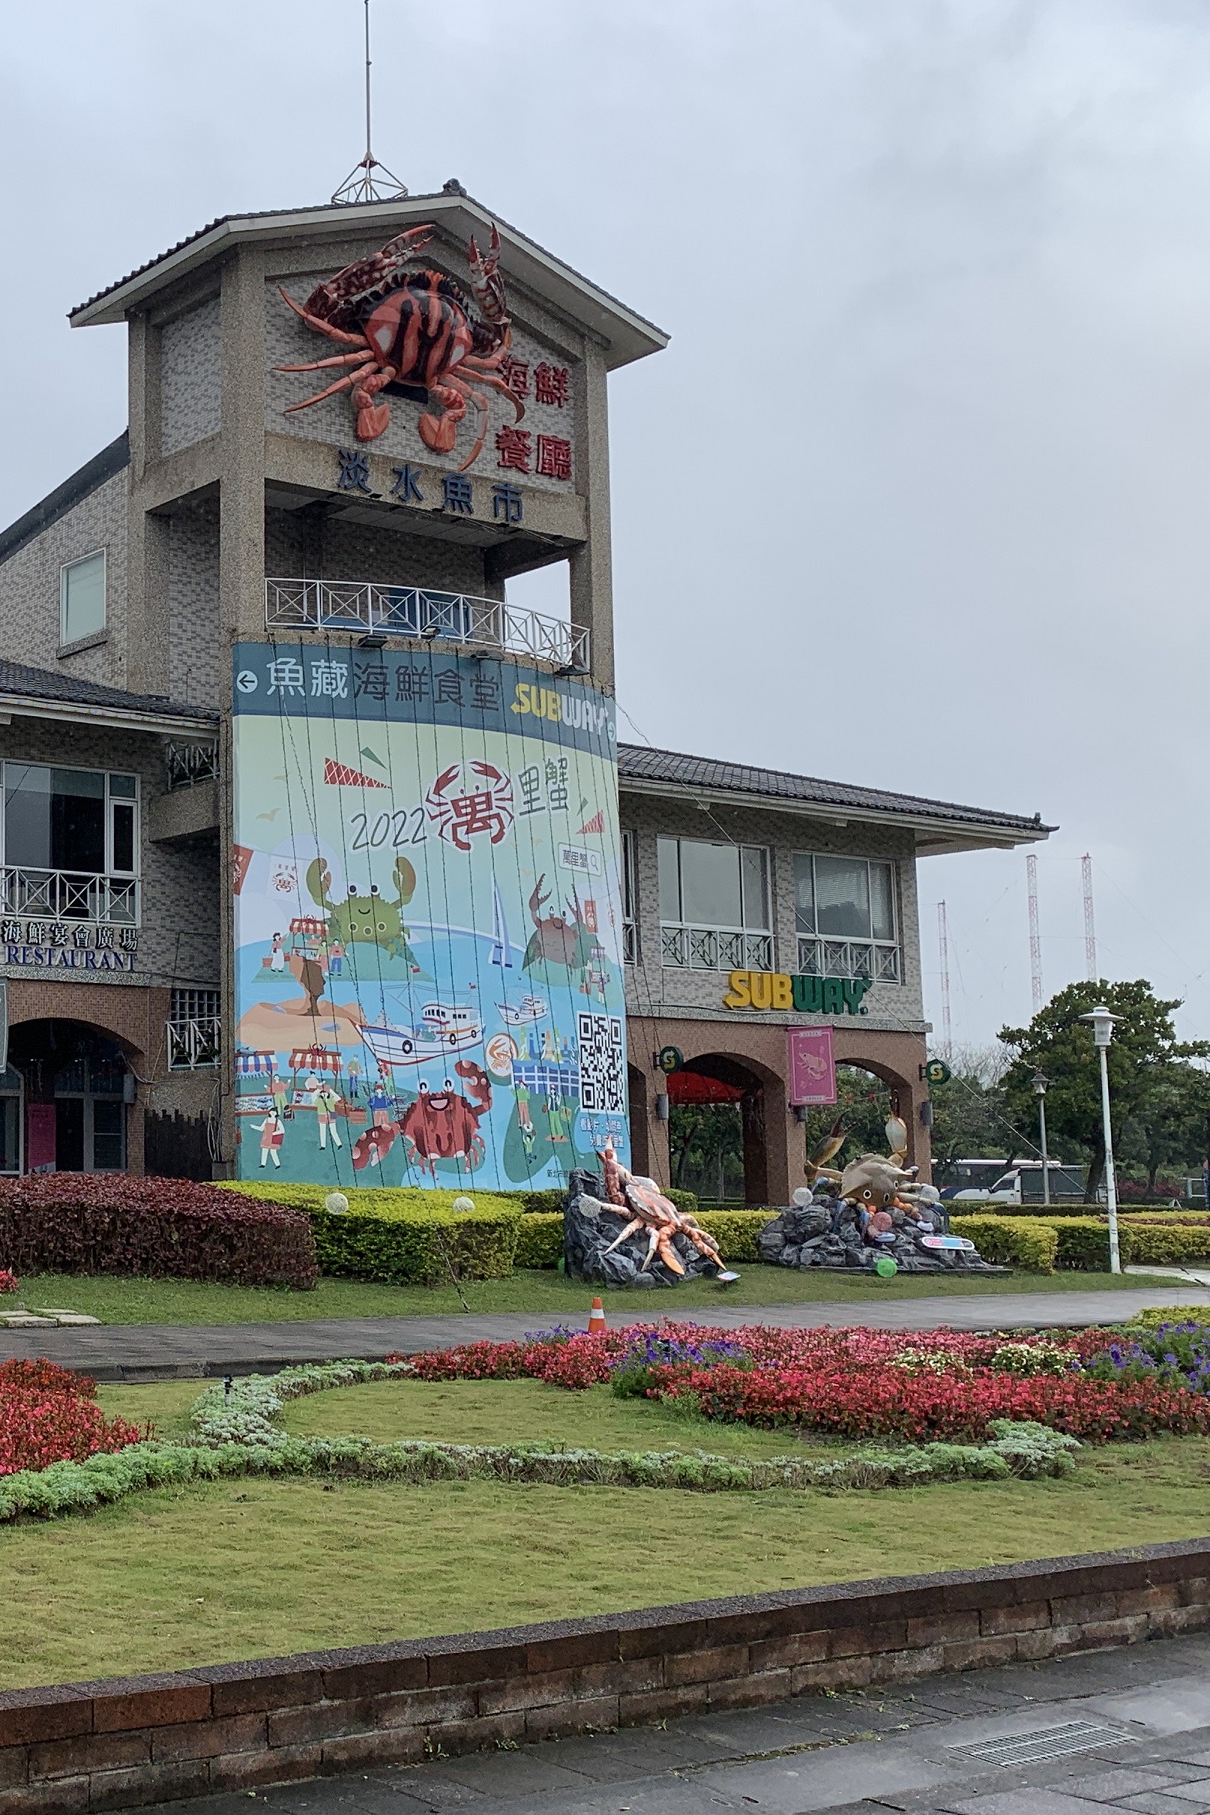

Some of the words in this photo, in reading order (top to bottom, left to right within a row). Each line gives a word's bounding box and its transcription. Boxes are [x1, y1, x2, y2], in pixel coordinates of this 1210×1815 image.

[496, 354, 570, 408] 海鮮
[495, 425, 573, 480] 餐廳
[338, 450, 524, 523] 淡水魚市
[510, 683, 609, 737] SUBWAY
[351, 807, 428, 851] 2022
[2, 920, 139, 952] 海鮮宴會廣場
[6, 945, 139, 972] RESTAURANT
[722, 970, 873, 1016] SUBWAY
